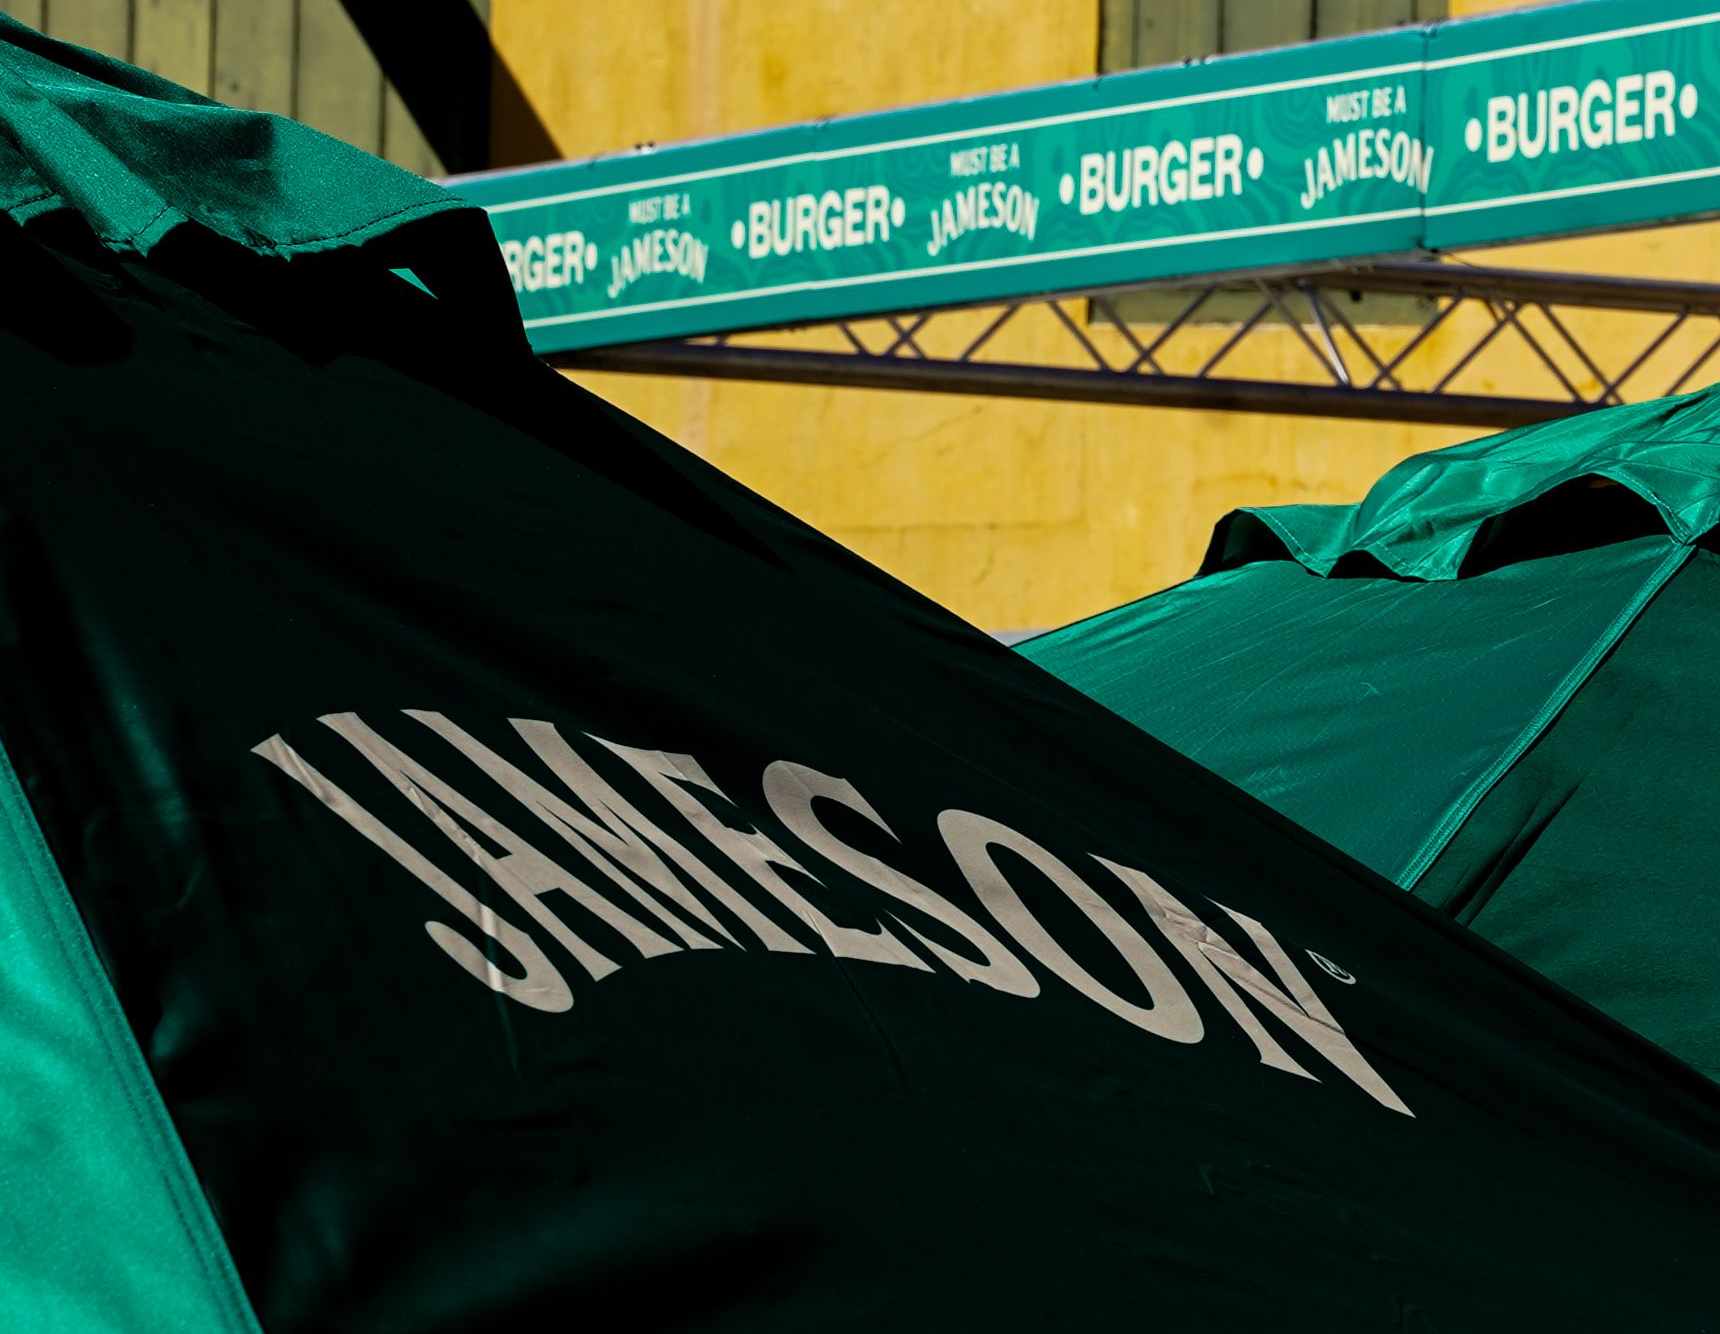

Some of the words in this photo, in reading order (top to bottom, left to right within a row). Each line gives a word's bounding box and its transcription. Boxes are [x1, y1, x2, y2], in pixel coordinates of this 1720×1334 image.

[1326, 90, 1370, 123] MUST
[1372, 87, 1392, 119] BE
[1393, 85, 1407, 114] A
[1487, 69, 1676, 163] BURGER
[950, 147, 988, 176] MUST
[989, 143, 1008, 172] BE
[1008, 142, 1020, 168] A
[1079, 133, 1242, 215] BURGER
[1300, 128, 1433, 210] JAMESON
[681, 193, 691, 215] A
[748, 185, 890, 259] BURGER
[927, 181, 1039, 256] JAMESON
[607, 228, 708, 298] JAMESON
